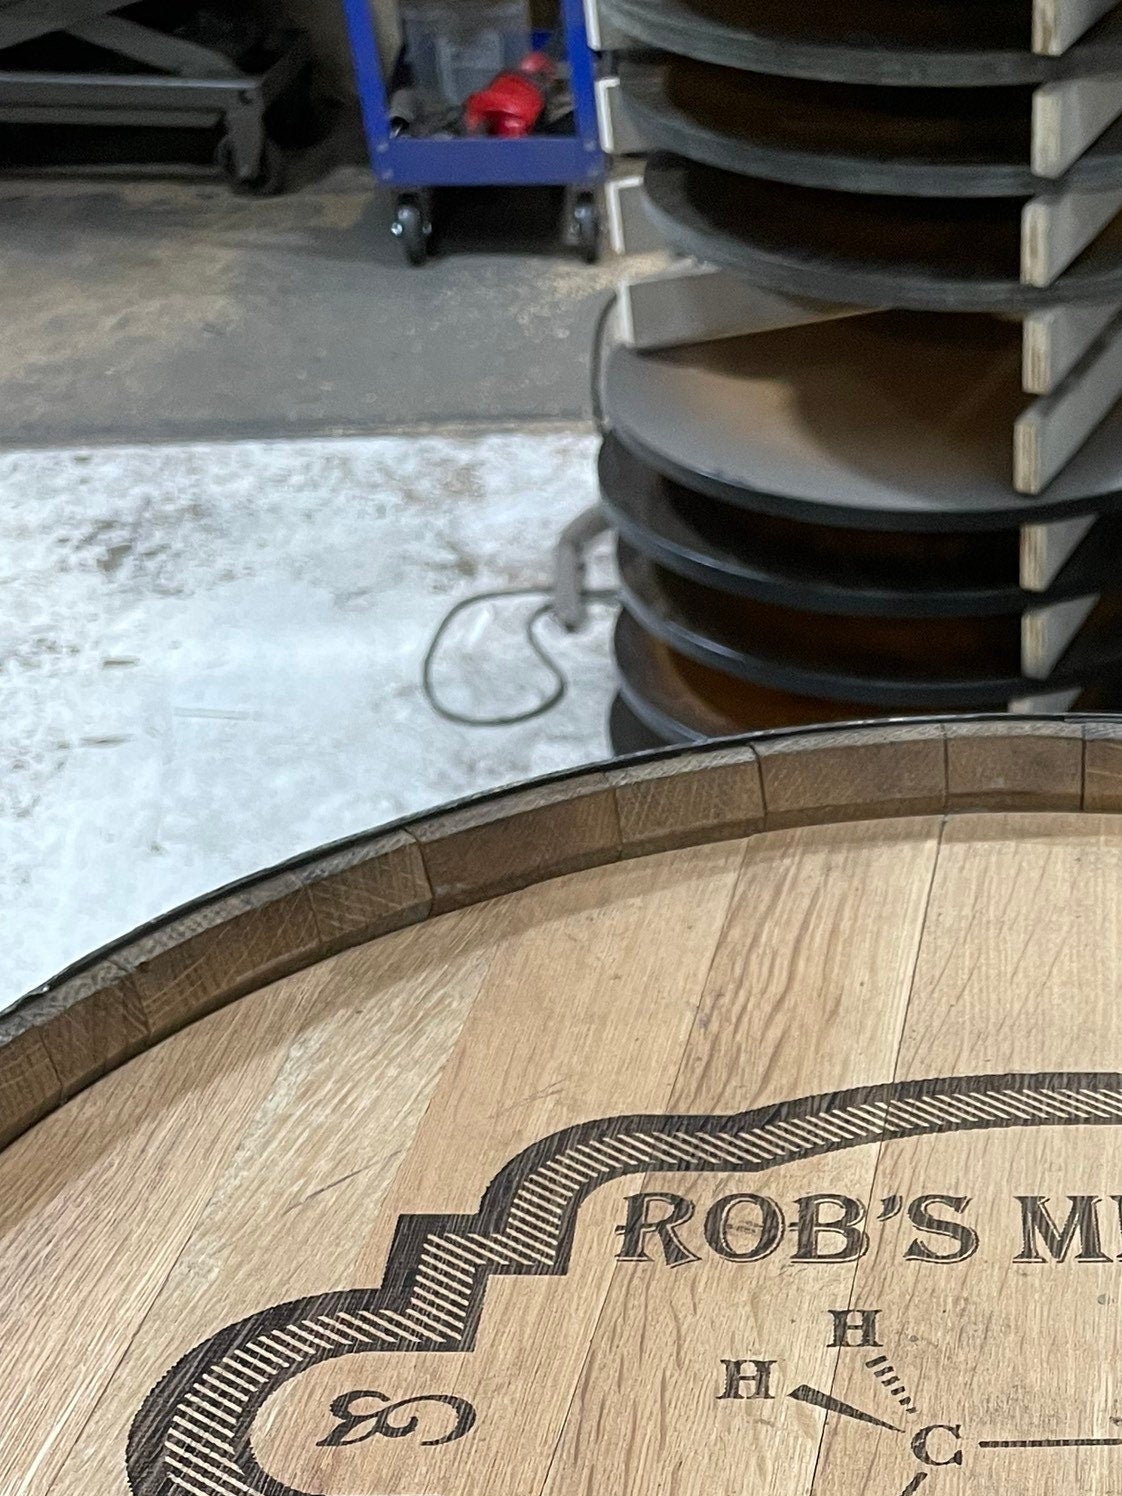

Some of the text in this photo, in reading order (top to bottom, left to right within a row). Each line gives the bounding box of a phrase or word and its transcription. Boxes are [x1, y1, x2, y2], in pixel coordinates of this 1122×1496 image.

[615, 1191, 980, 1268] ROB'S
[826, 1308, 883, 1349] H
[717, 1359, 777, 1400] H
[910, 1423, 963, 1466] C
